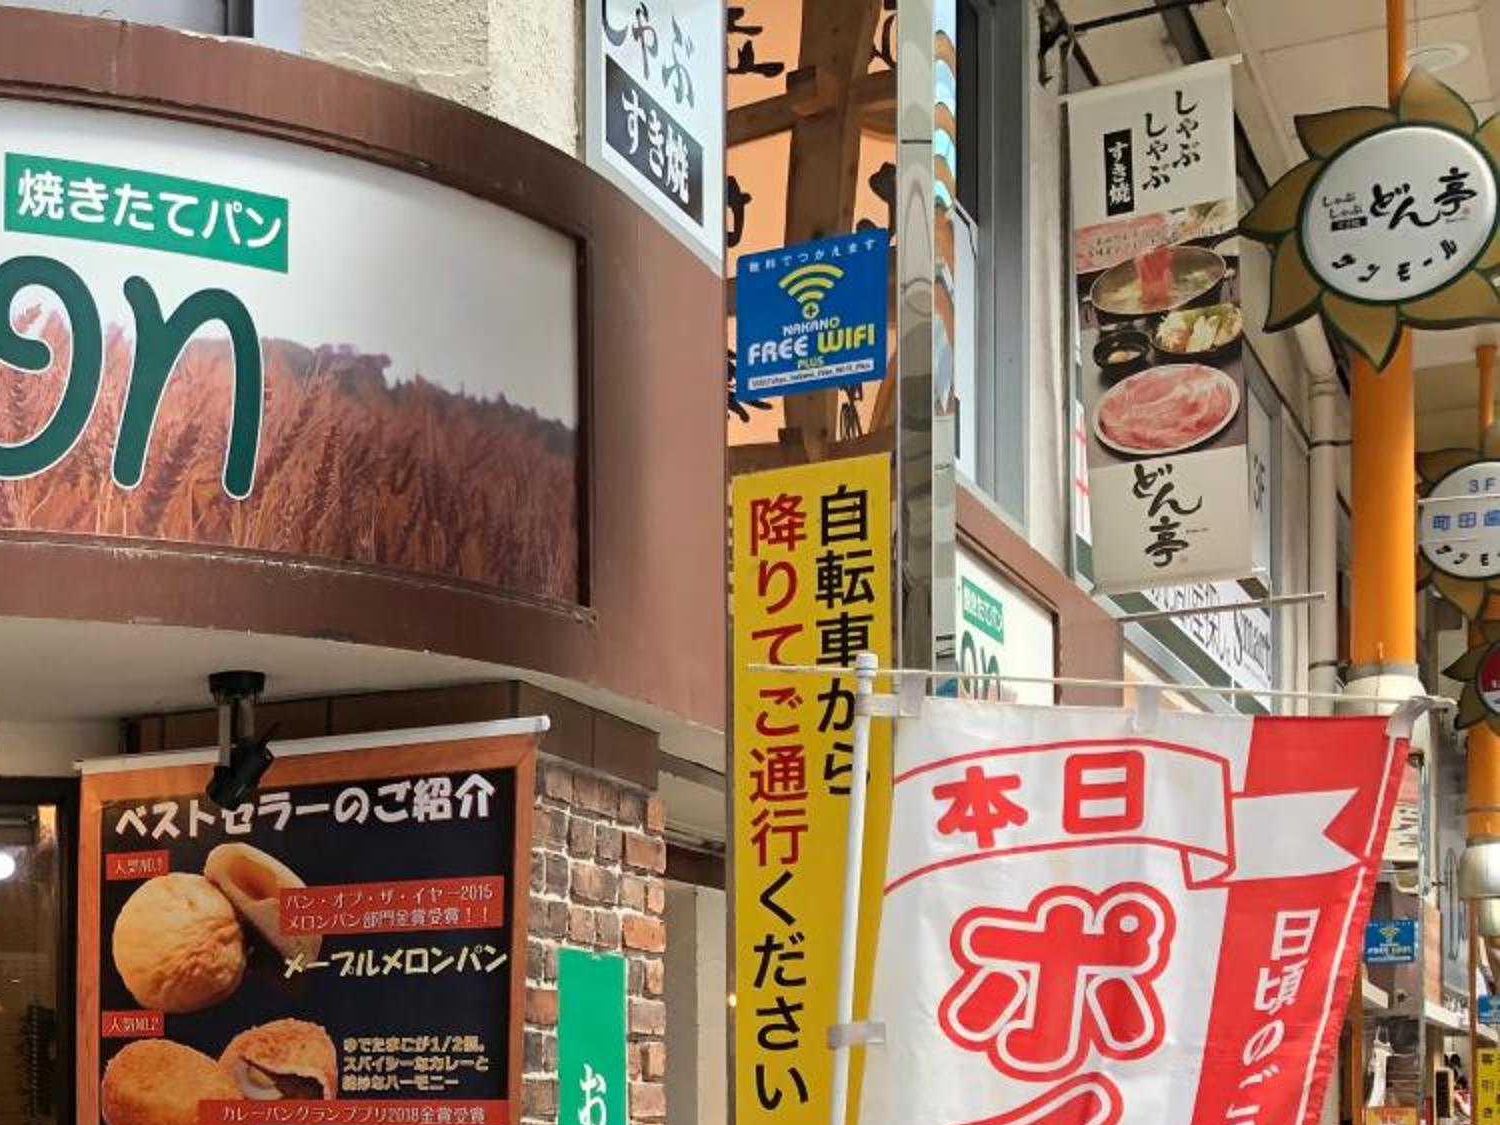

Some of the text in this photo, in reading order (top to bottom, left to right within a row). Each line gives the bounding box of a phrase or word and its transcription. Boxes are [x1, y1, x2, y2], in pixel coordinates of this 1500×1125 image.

[621, 89, 689, 204] すき焼
[17, 168, 287, 250] 焼きたてパン
[1371, 167, 1477, 230] どん亭
[748, 336, 809, 366] FREE
[783, 317, 841, 337] NAKANO
[1133, 463, 1203, 567] どん亭
[115, 773, 496, 841] ベストセラーのご紹介
[749, 493, 810, 1112] 降りてご通行ください
[932, 749, 1145, 849] 本日
[283, 944, 508, 980] メープルメロンパン
[343, 1055, 489, 1073] スパイシーなカレーと
